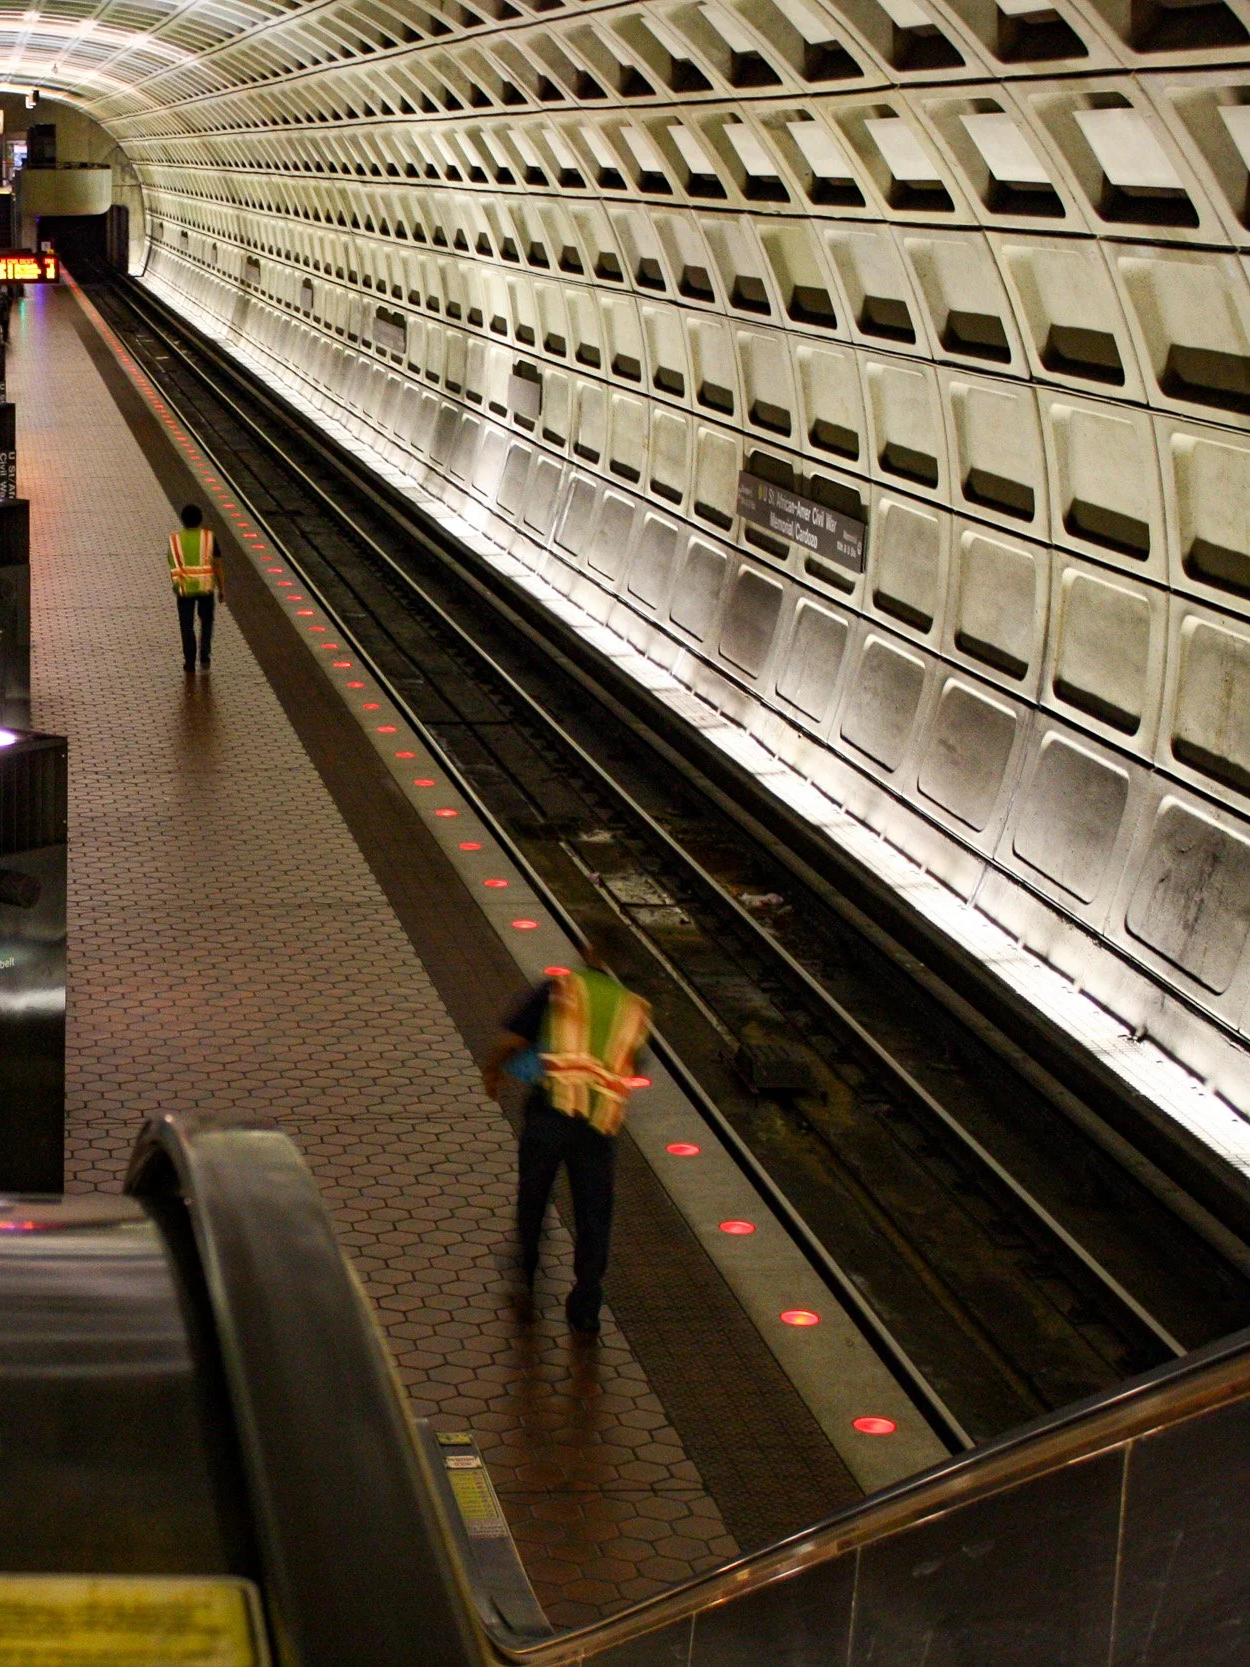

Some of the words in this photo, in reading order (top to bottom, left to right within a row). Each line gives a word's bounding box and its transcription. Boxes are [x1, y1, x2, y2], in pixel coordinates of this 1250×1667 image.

[0, 452, 7, 476] Civil
[812, 507, 825, 528] Civil
[825, 512, 838, 533] War
